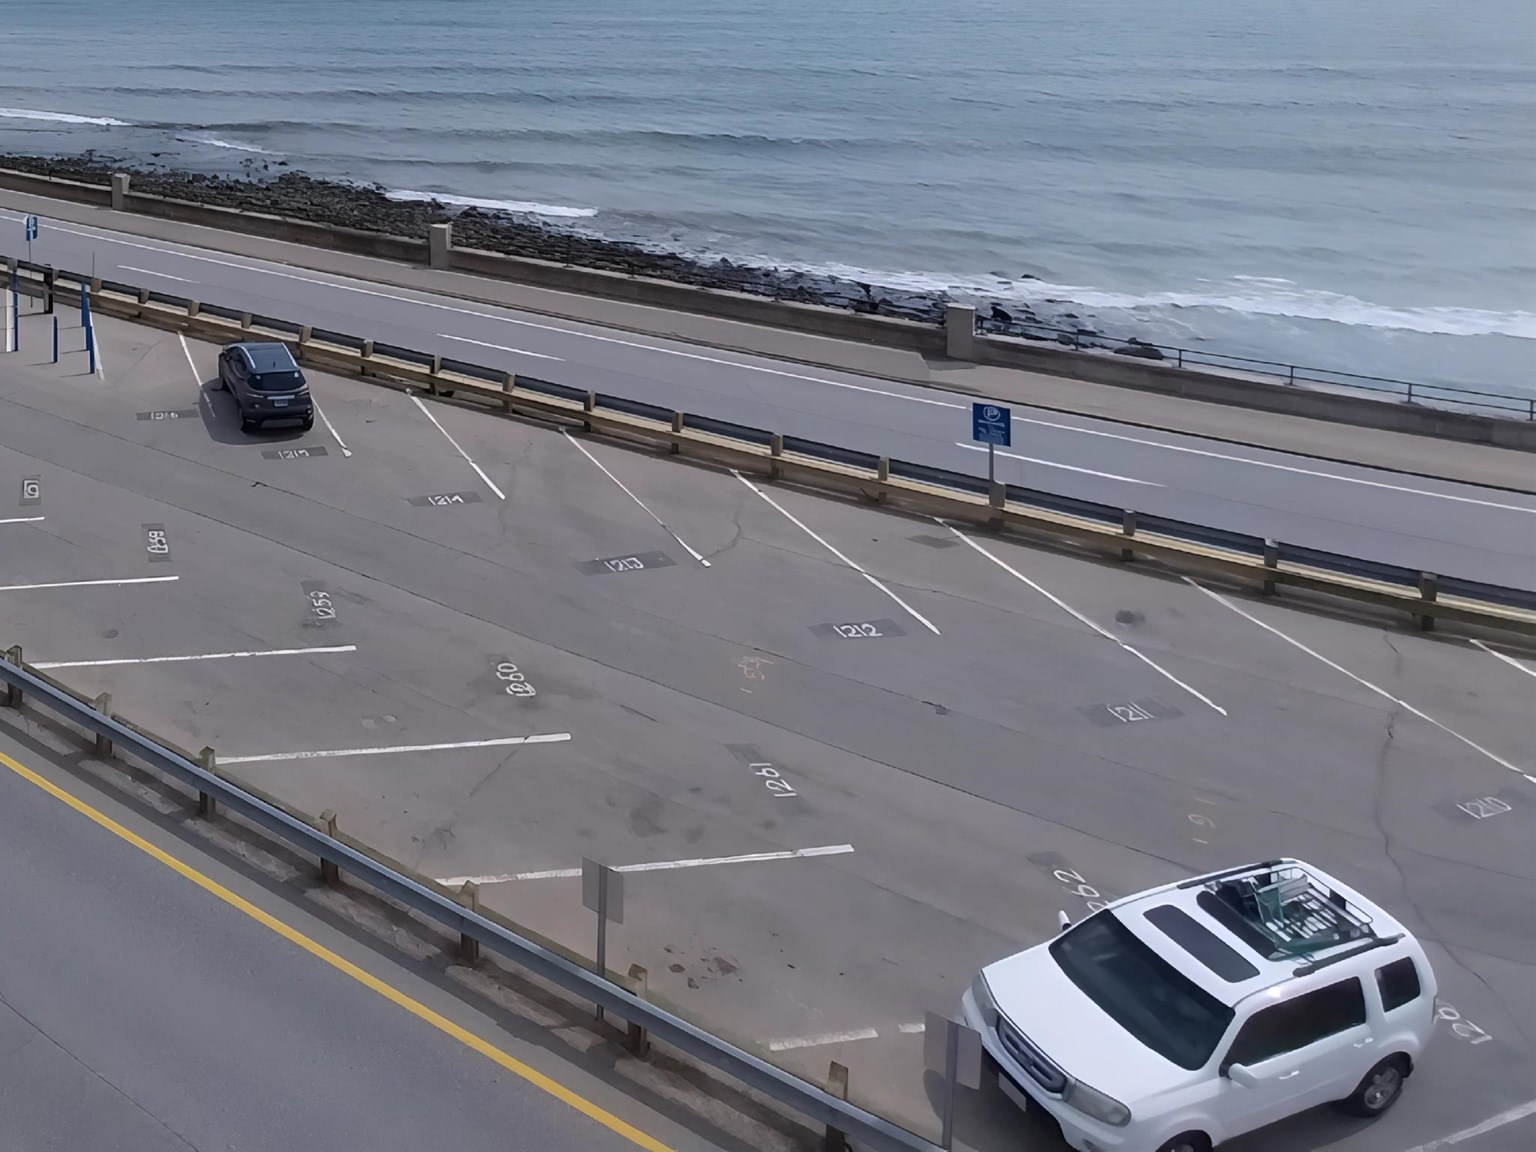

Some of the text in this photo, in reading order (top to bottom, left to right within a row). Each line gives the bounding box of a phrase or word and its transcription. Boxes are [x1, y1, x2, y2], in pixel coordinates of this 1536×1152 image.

[832, 623, 884, 638] 1212
[1105, 701, 1156, 723] 1211
[749, 762, 798, 798] 1261
